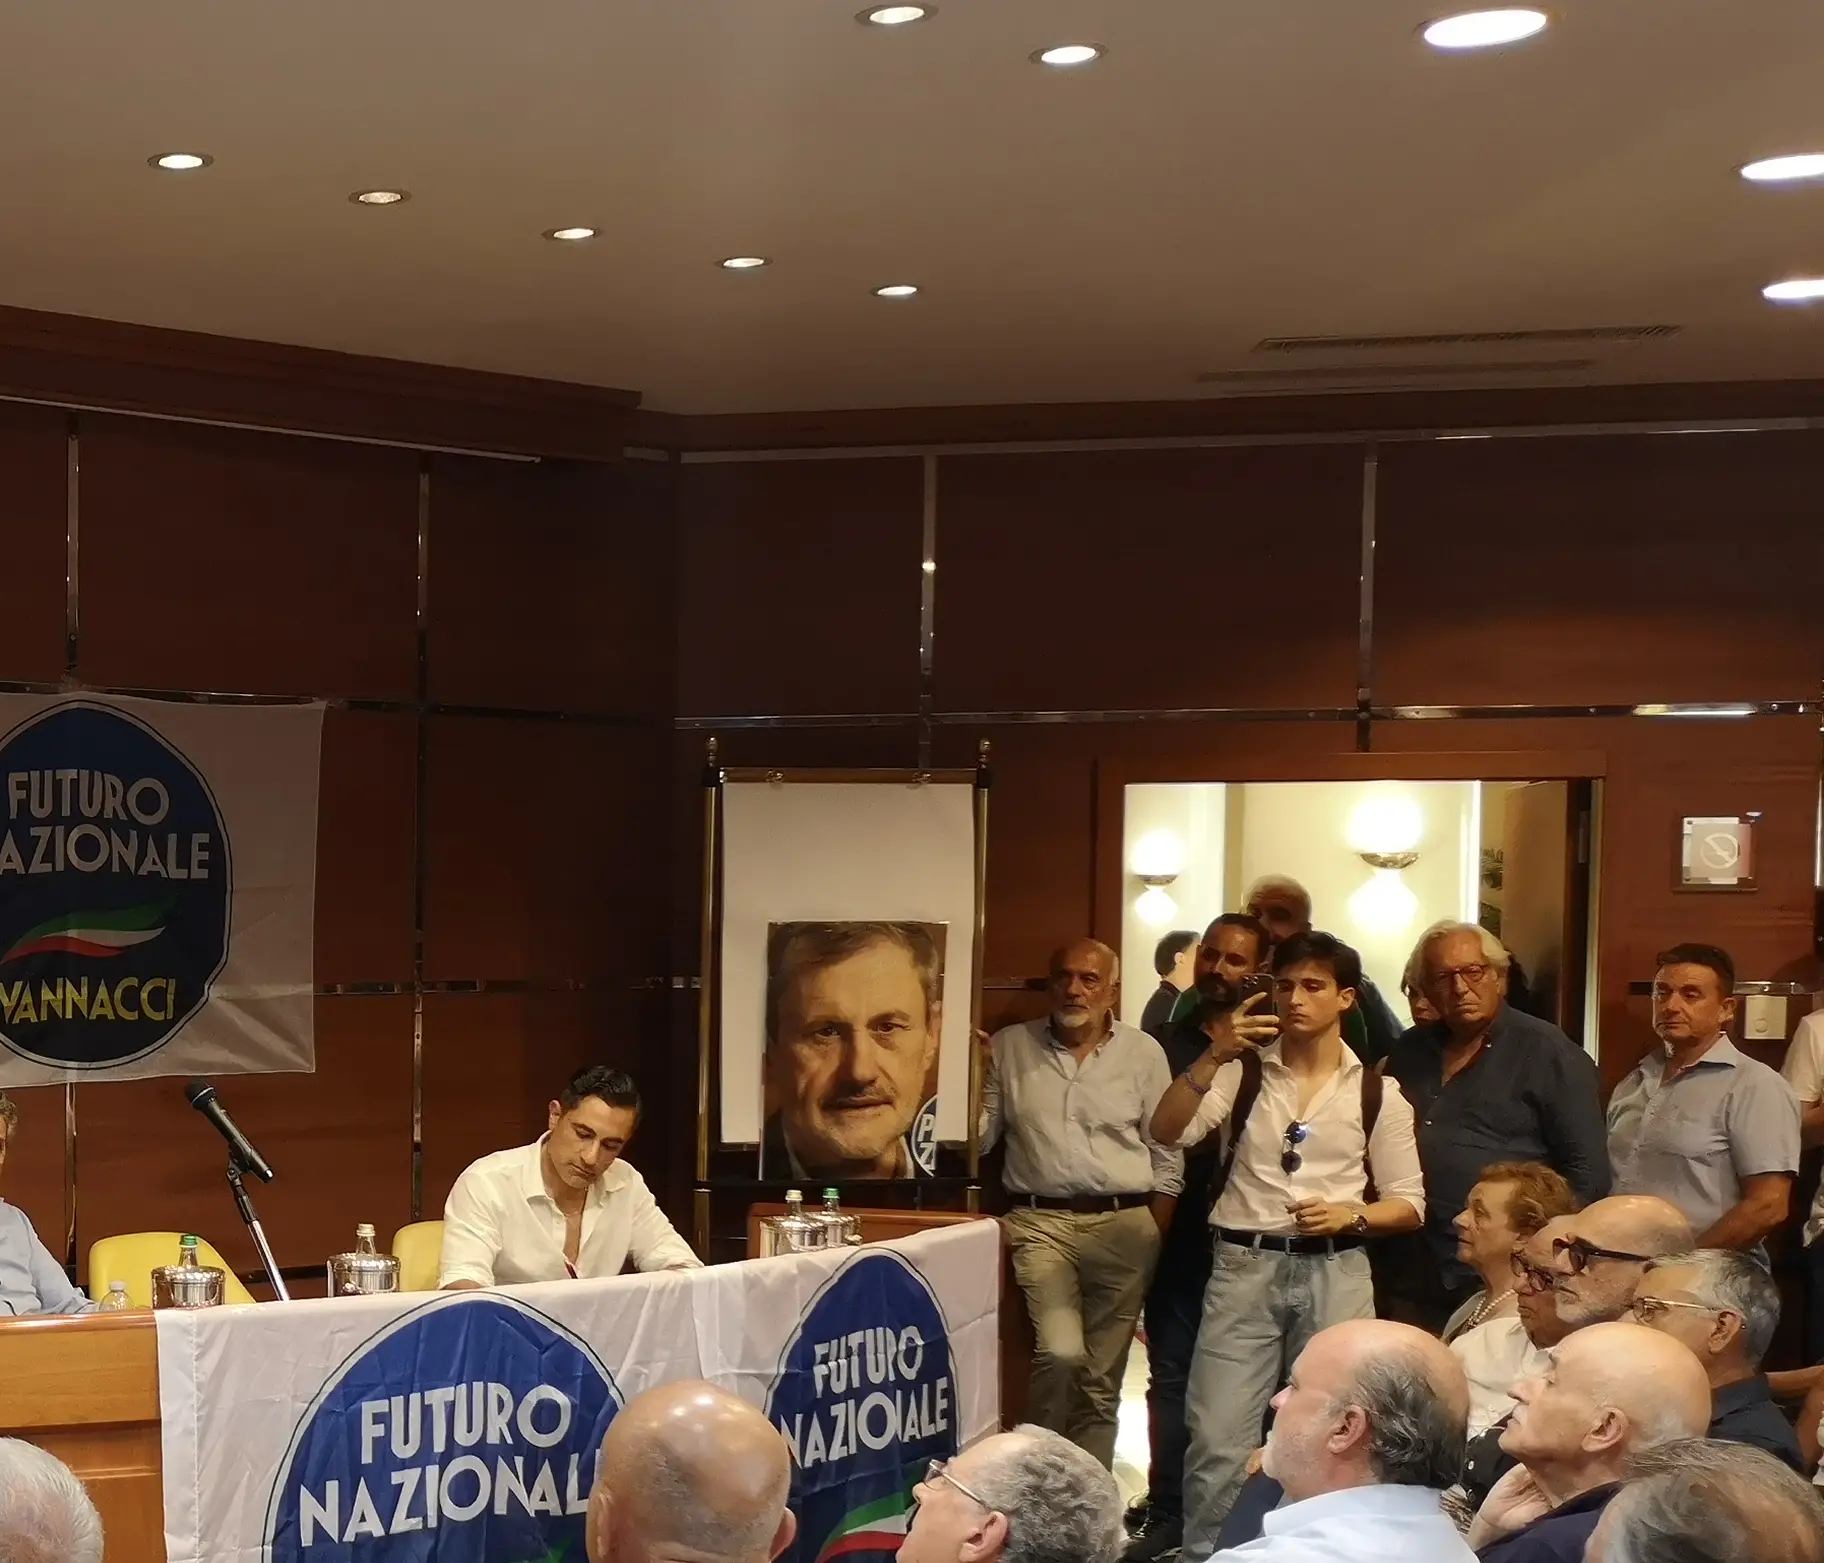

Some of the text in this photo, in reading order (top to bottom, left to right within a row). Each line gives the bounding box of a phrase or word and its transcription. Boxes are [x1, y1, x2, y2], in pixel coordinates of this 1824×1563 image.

[7, 768, 170, 825] FUTURO
[813, 1326, 925, 1398] FUTURO
[361, 1381, 572, 1464] FUTURO
[780, 1376, 948, 1469] NAZIONALE
[299, 1448, 601, 1547] NAZIONAL
